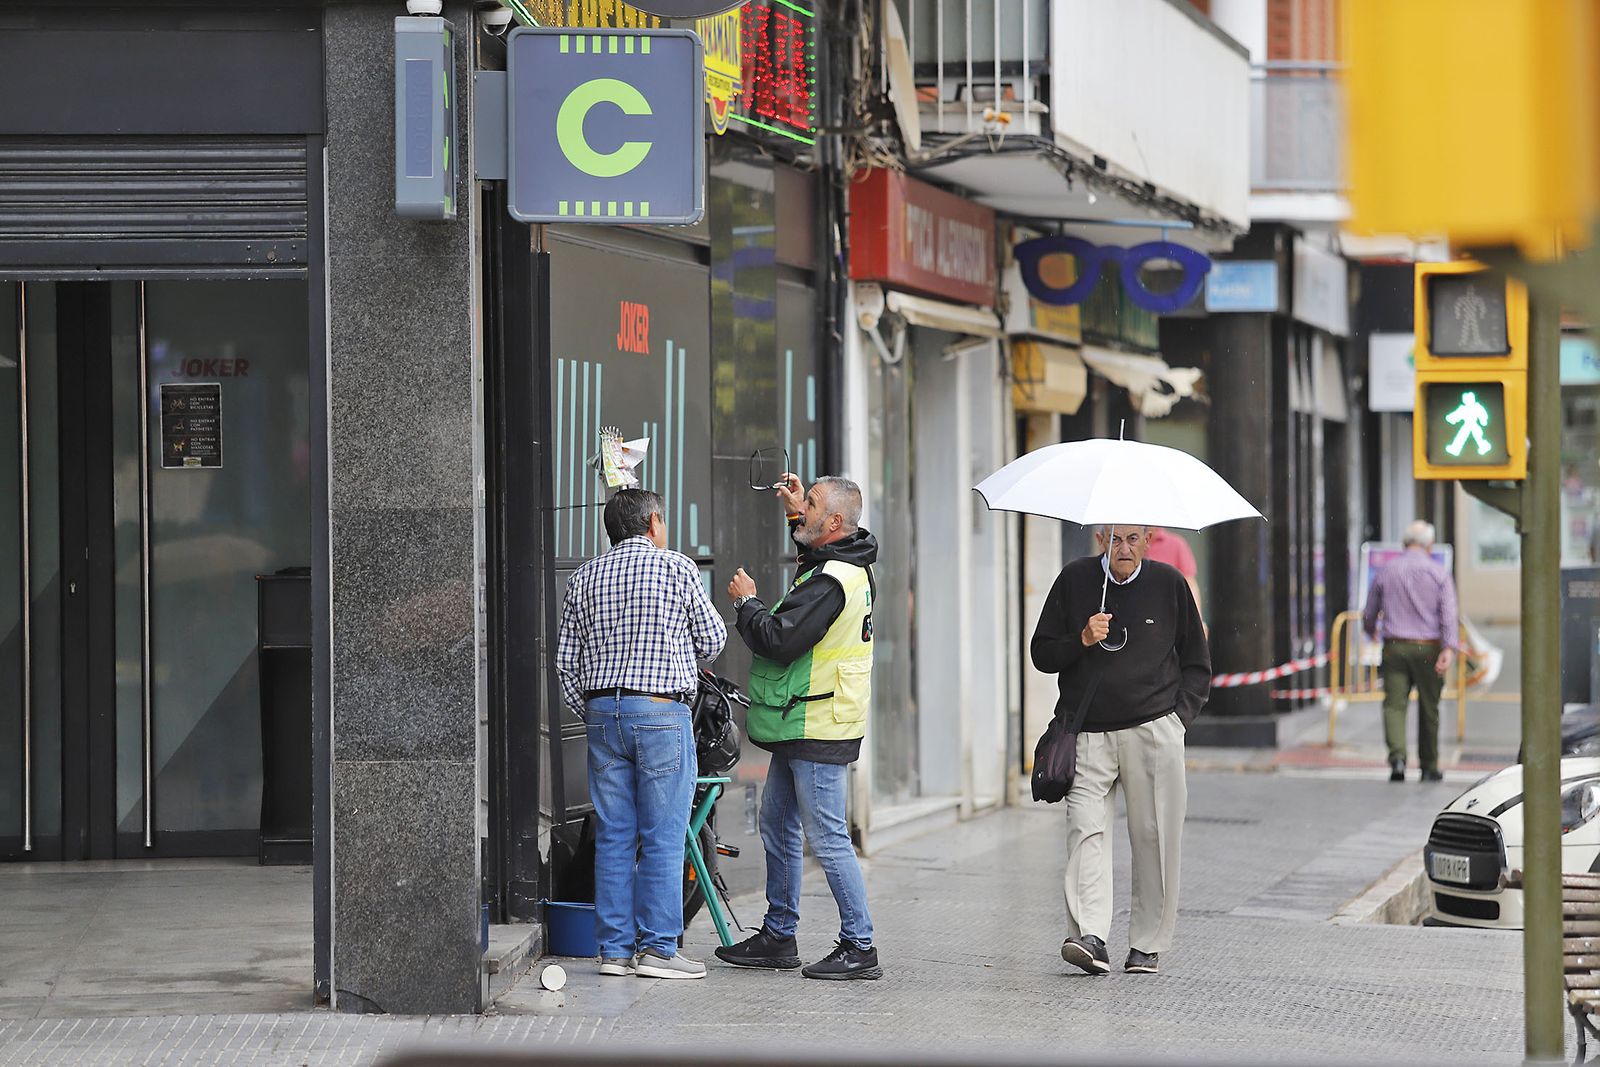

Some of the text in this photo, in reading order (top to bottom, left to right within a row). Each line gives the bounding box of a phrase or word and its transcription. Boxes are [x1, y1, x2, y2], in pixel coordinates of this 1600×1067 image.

[556, 78, 653, 178] C
[617, 300, 650, 354] JOKER
[171, 357, 250, 377] JOKER
